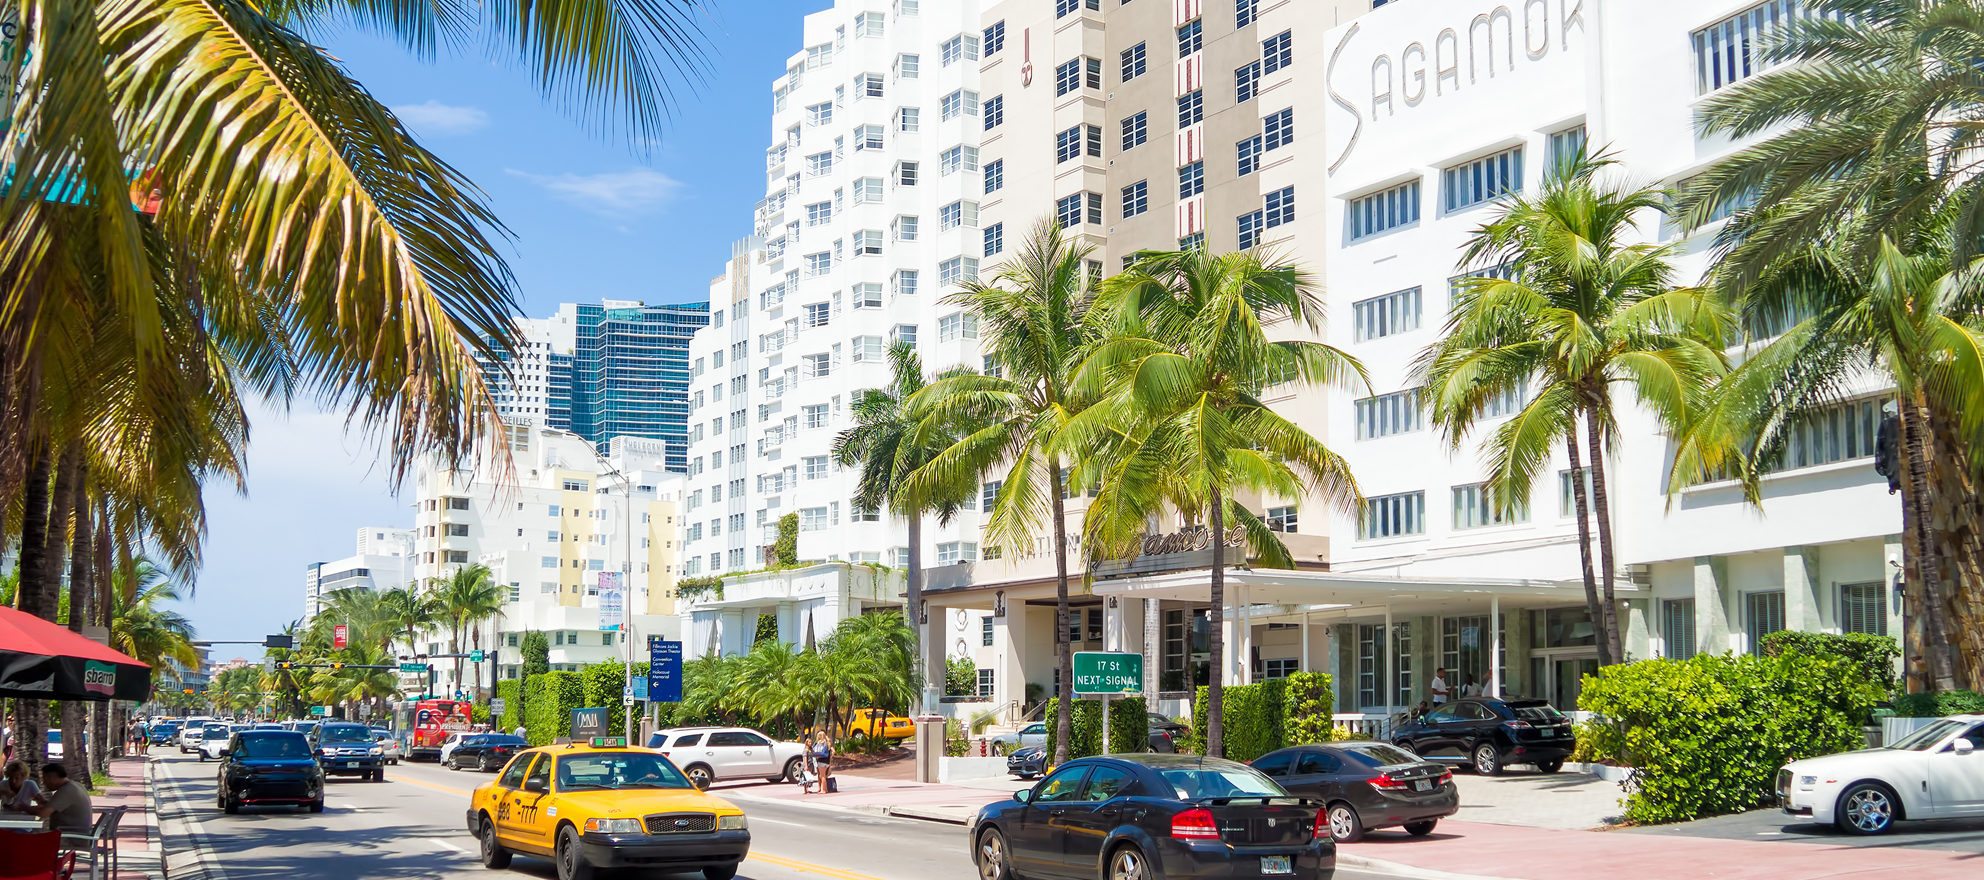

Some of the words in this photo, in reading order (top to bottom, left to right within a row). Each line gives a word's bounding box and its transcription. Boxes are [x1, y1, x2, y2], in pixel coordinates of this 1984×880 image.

[1097, 661, 1106, 671] 17
[1110, 661, 1120, 671] St
[86, 667, 114, 685] sbarro
[1077, 675, 1100, 685] NEXT
[1105, 675, 1139, 685] SIGNAL
